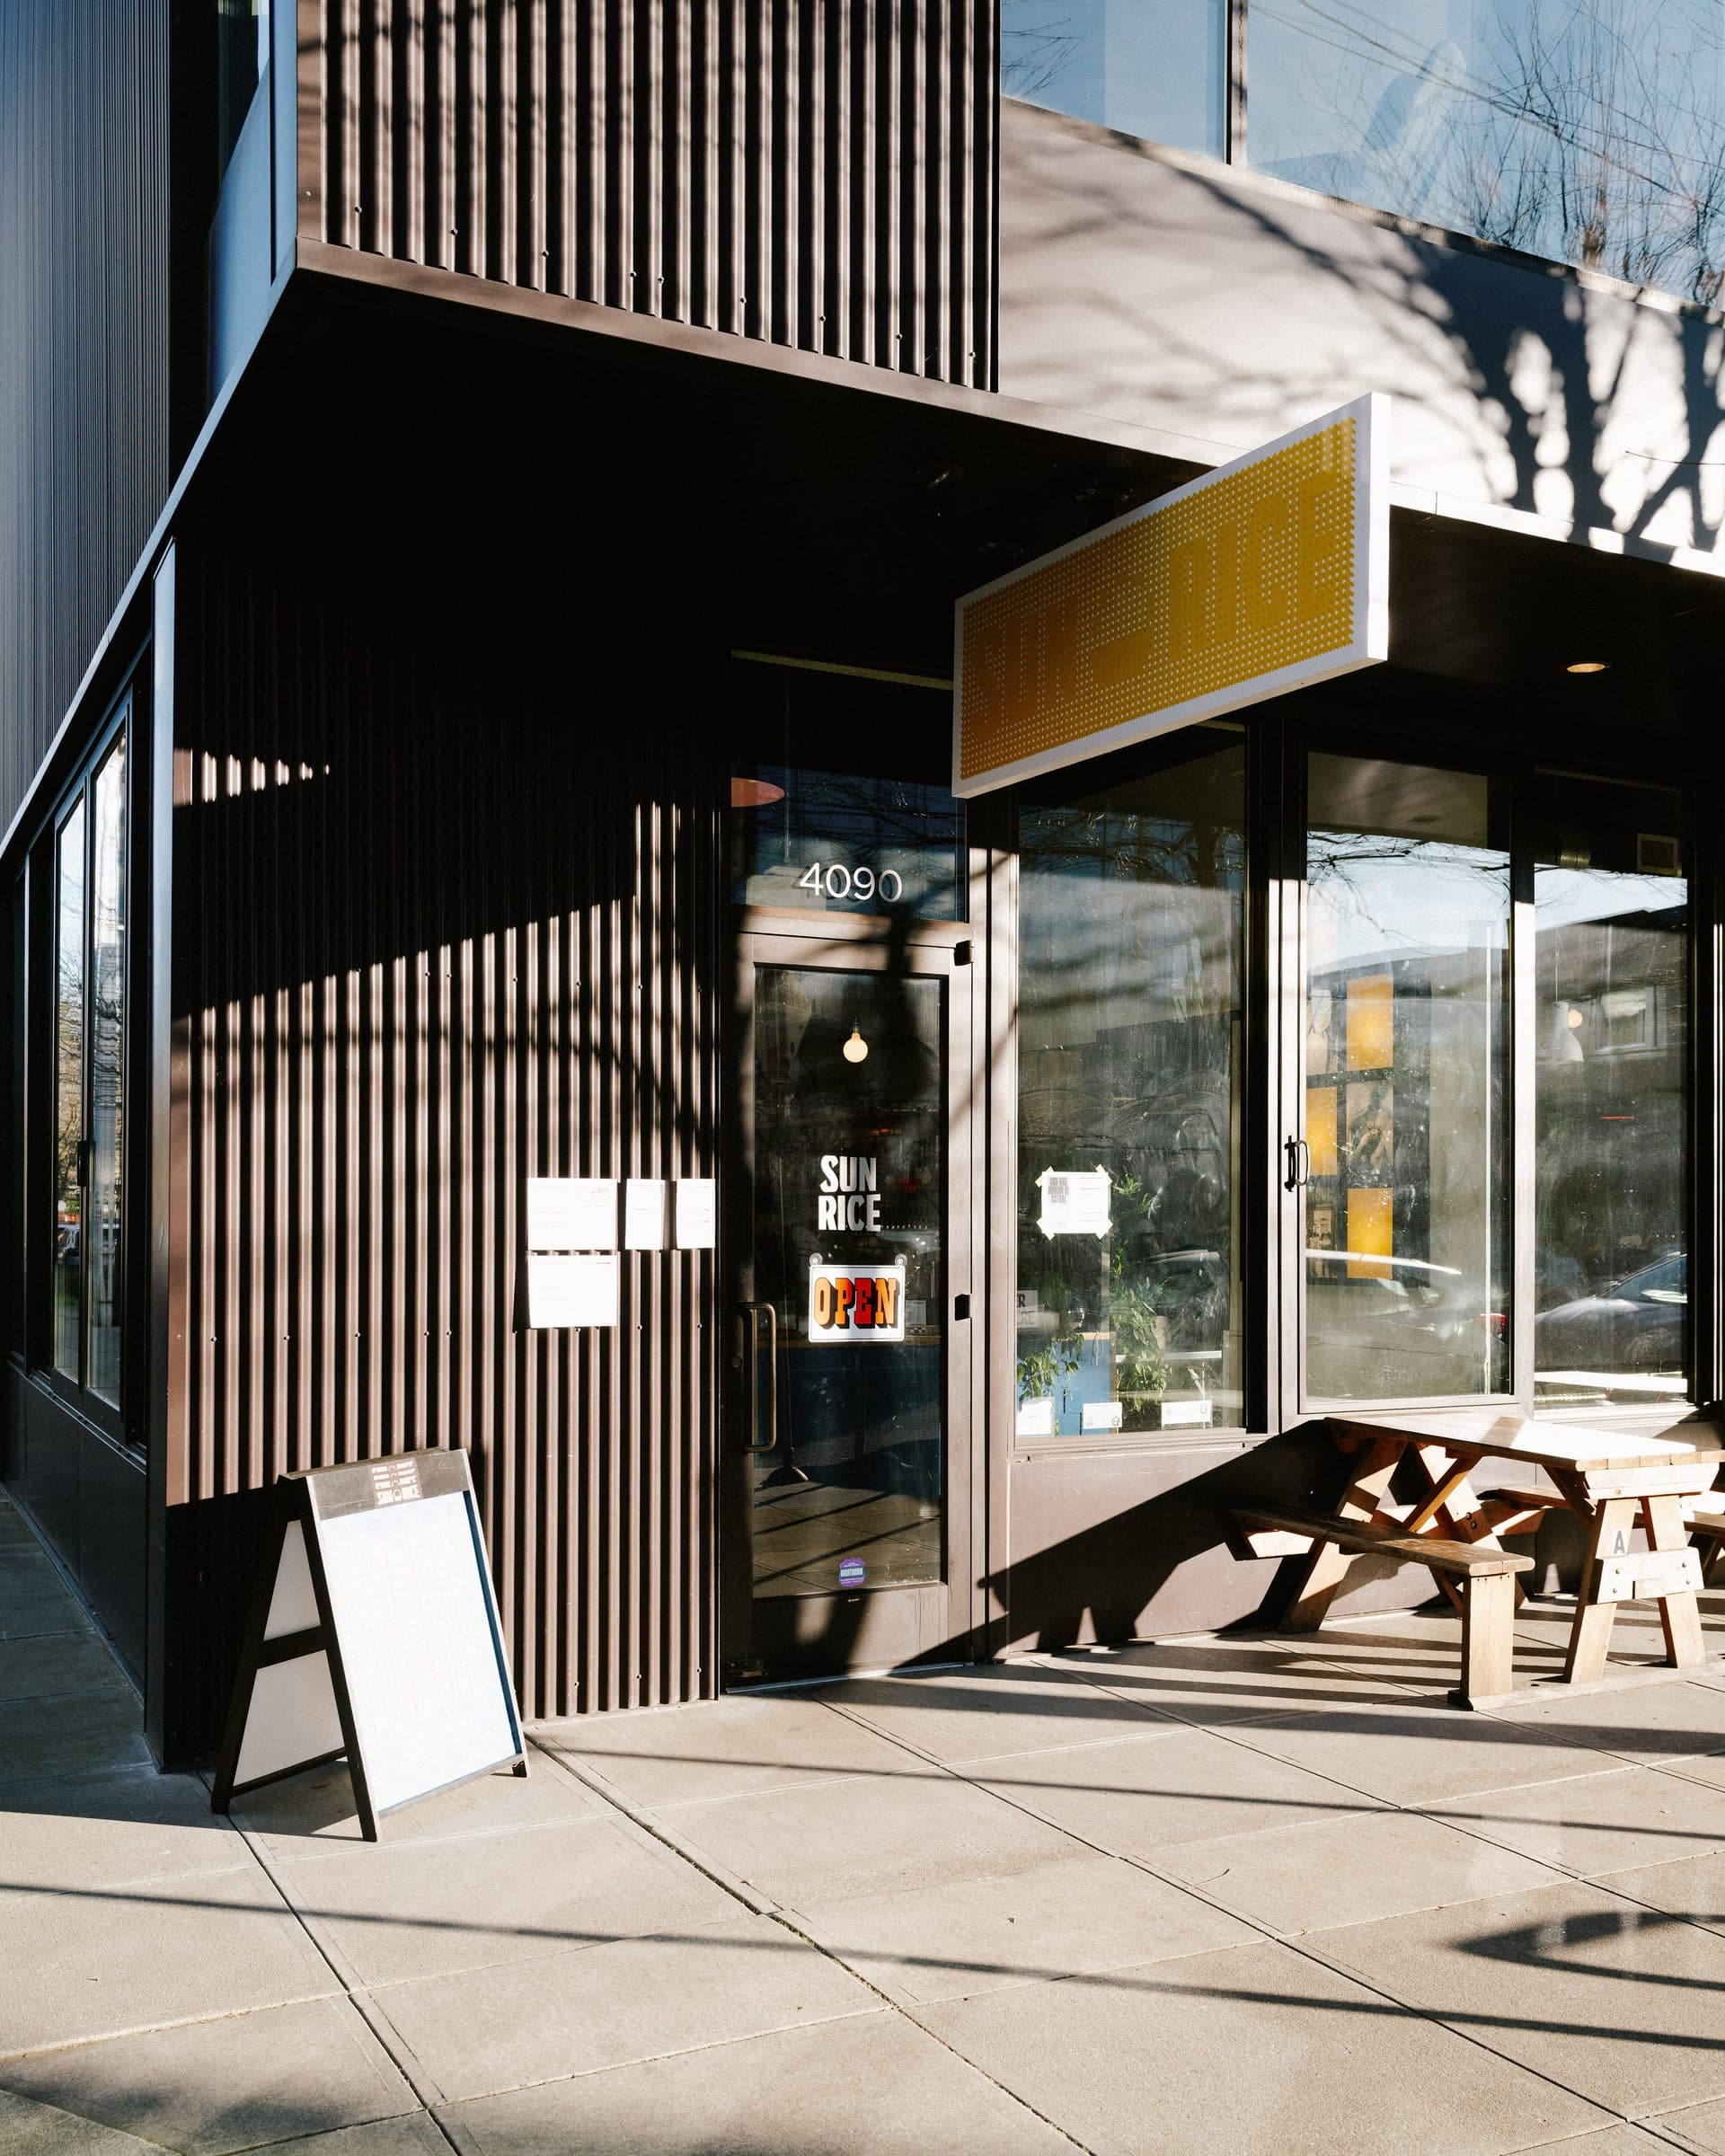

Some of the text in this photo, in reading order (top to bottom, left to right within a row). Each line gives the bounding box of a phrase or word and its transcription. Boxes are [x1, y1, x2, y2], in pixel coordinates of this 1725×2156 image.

[972, 471, 1339, 741] SUN RICE
[800, 862, 903, 903] 4090
[819, 1154, 877, 1193] SUN
[818, 1194, 881, 1232] RICE
[814, 1277, 900, 1329] OPEN
[1614, 1531, 1626, 1554] A
